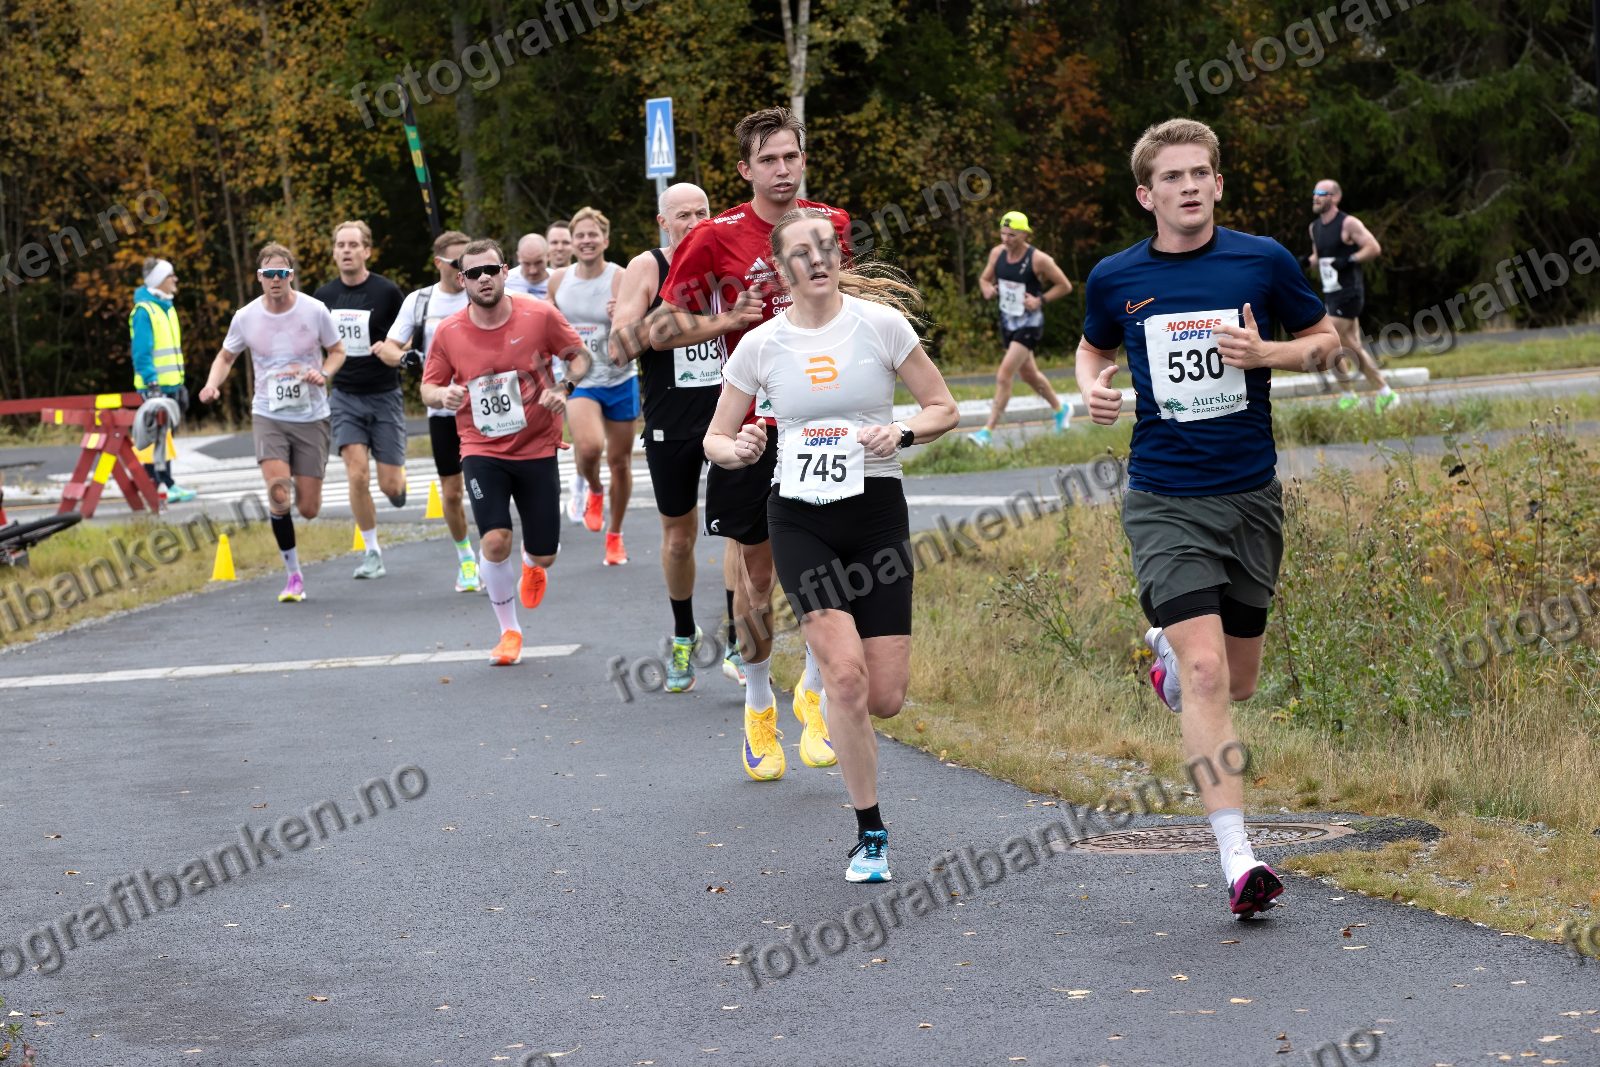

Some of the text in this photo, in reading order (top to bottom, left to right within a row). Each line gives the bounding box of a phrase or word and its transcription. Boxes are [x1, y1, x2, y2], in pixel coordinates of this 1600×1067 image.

[1163, 319, 1222, 332] NORGES
[1172, 329, 1212, 341] LØPET
[685, 339, 720, 361] 603
[1168, 347, 1225, 383] 530
[276, 385, 301, 401] 949
[1192, 393, 1243, 407] Aurskog
[480, 394, 511, 416] 389
[1192, 404, 1235, 414] SPAREBANK
[801, 427, 849, 438] NORGES
[804, 436, 841, 447] LØPET
[797, 453, 847, 483] 745
